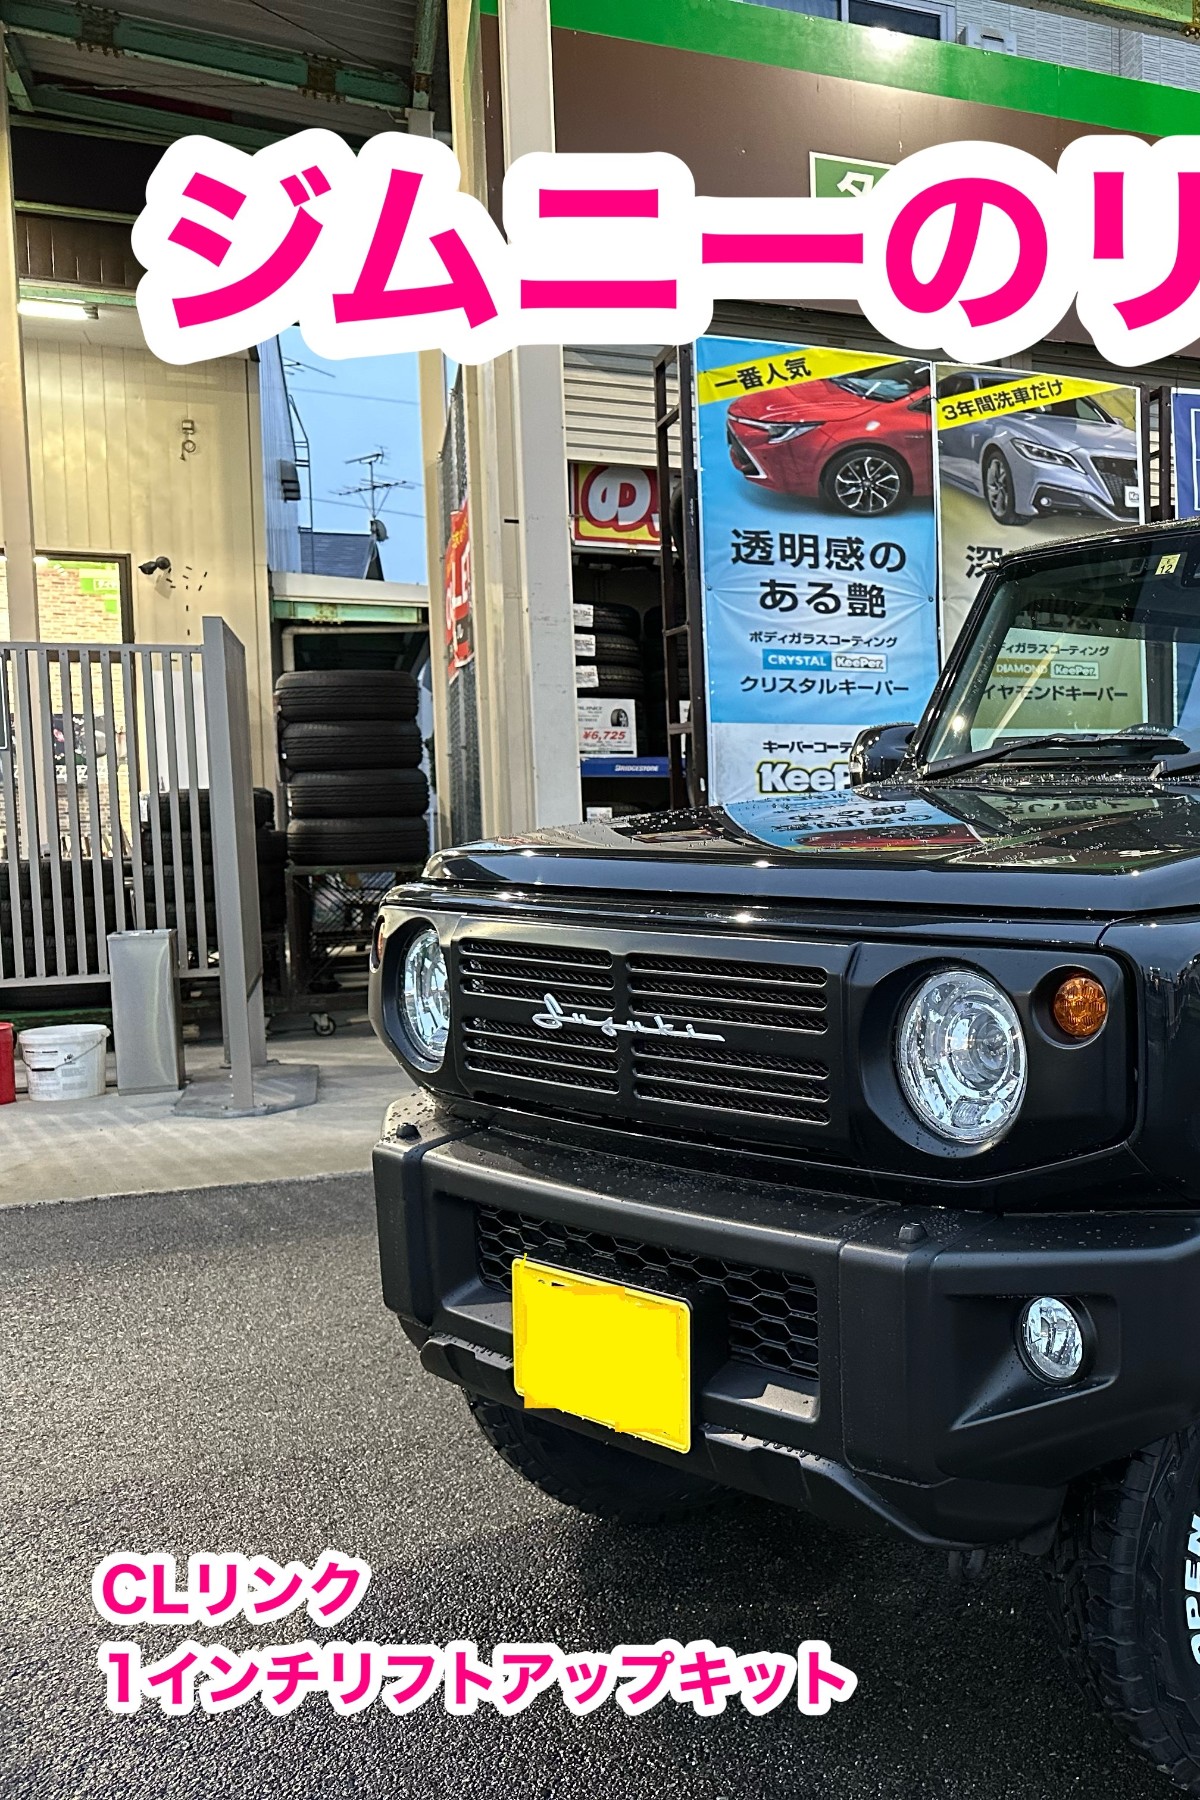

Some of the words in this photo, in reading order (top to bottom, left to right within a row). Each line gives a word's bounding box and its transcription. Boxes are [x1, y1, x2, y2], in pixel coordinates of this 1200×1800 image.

[714, 356, 811, 390] 一番人気
[942, 380, 1063, 420] 3年間洗車だけ
[731, 528, 906, 573] 透明感の
[759, 578, 887, 619] ある艶
[749, 631, 897, 648] ボディガラスコーティング
[767, 654, 827, 666] CRYSTAL
[835, 656, 884, 669] KeePer
[996, 664, 1048, 675] DIAMOND
[1053, 664, 1097, 677] KeePer
[740, 675, 909, 696] クリスタルキーパー
[583, 730, 626, 741] ¥6,725
[614, 764, 659, 772] BRIDGESTONE
